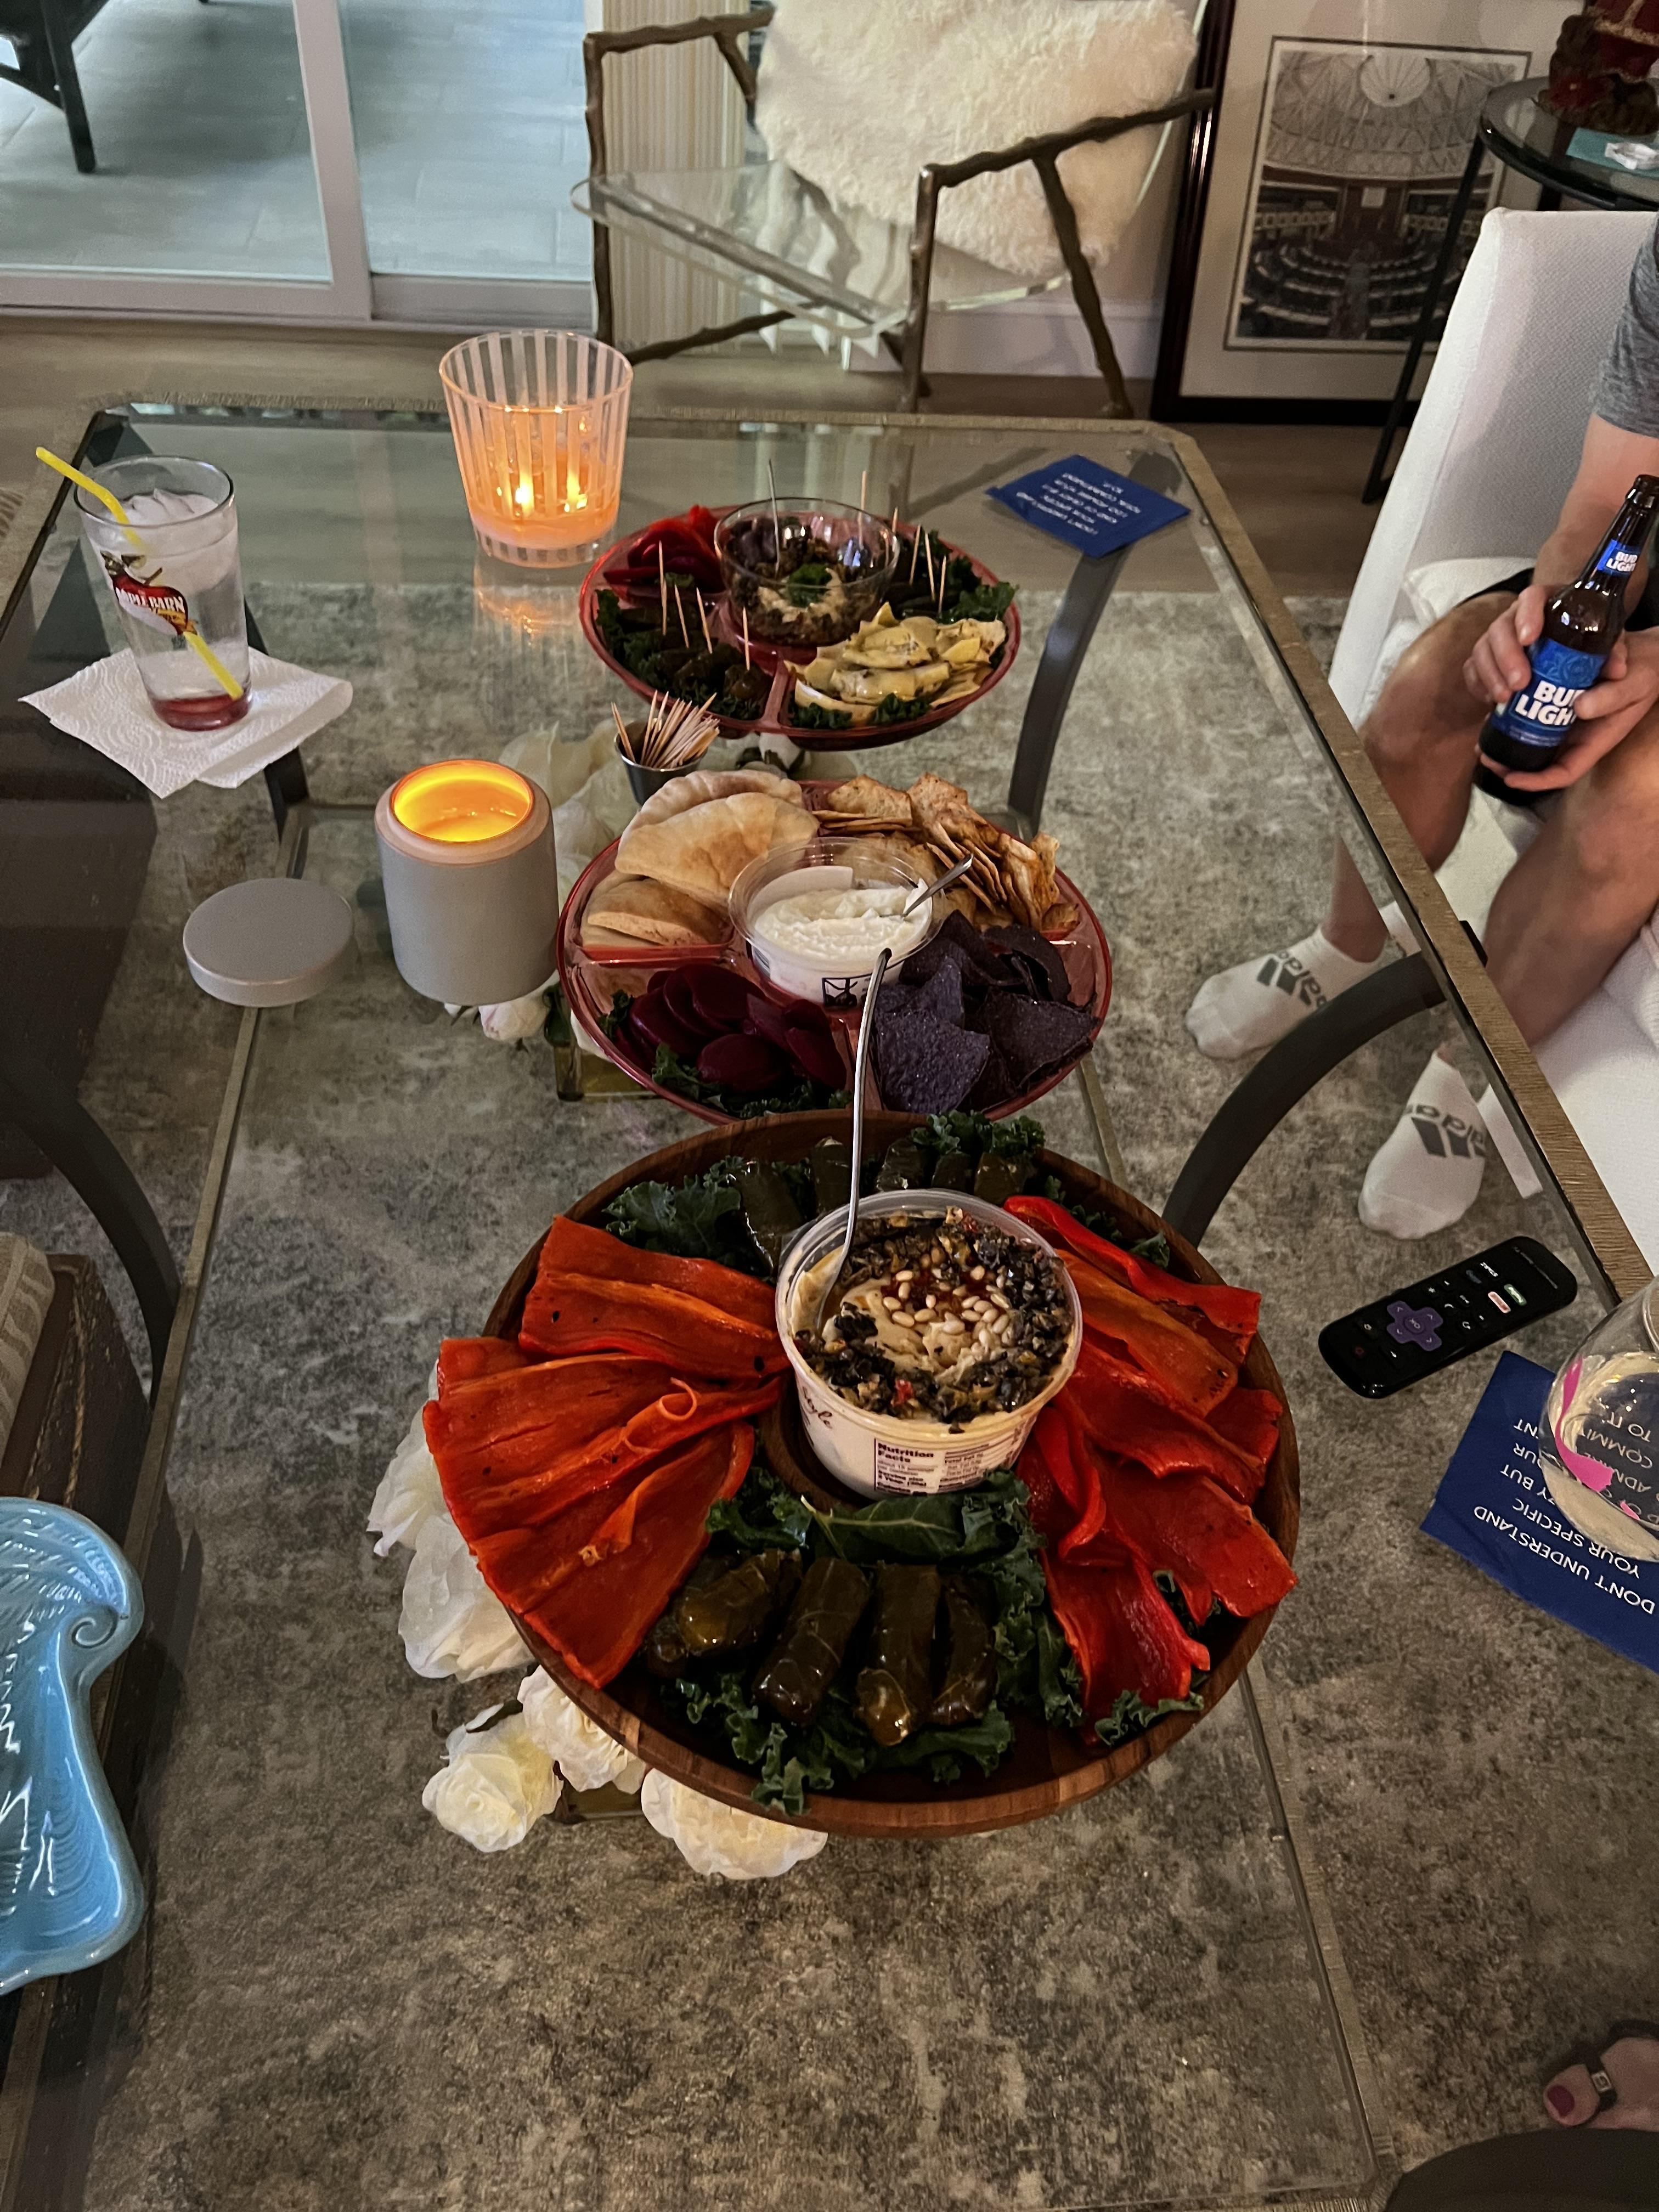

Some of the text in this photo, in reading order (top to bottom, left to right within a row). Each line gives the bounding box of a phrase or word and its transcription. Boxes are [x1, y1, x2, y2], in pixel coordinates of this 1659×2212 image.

[1616, 551, 1638, 563] BUD
[1628, 1423, 1652, 1443] TO
[878, 1442, 934, 1458] Nutrition
[878, 1449, 911, 1463] Facts
[1499, 1463, 1534, 1491] BUT
[1513, 1497, 1640, 1578] YOUR SPECIFIC
[1474, 1506, 1656, 1615] DON'T UNDERSTAND
